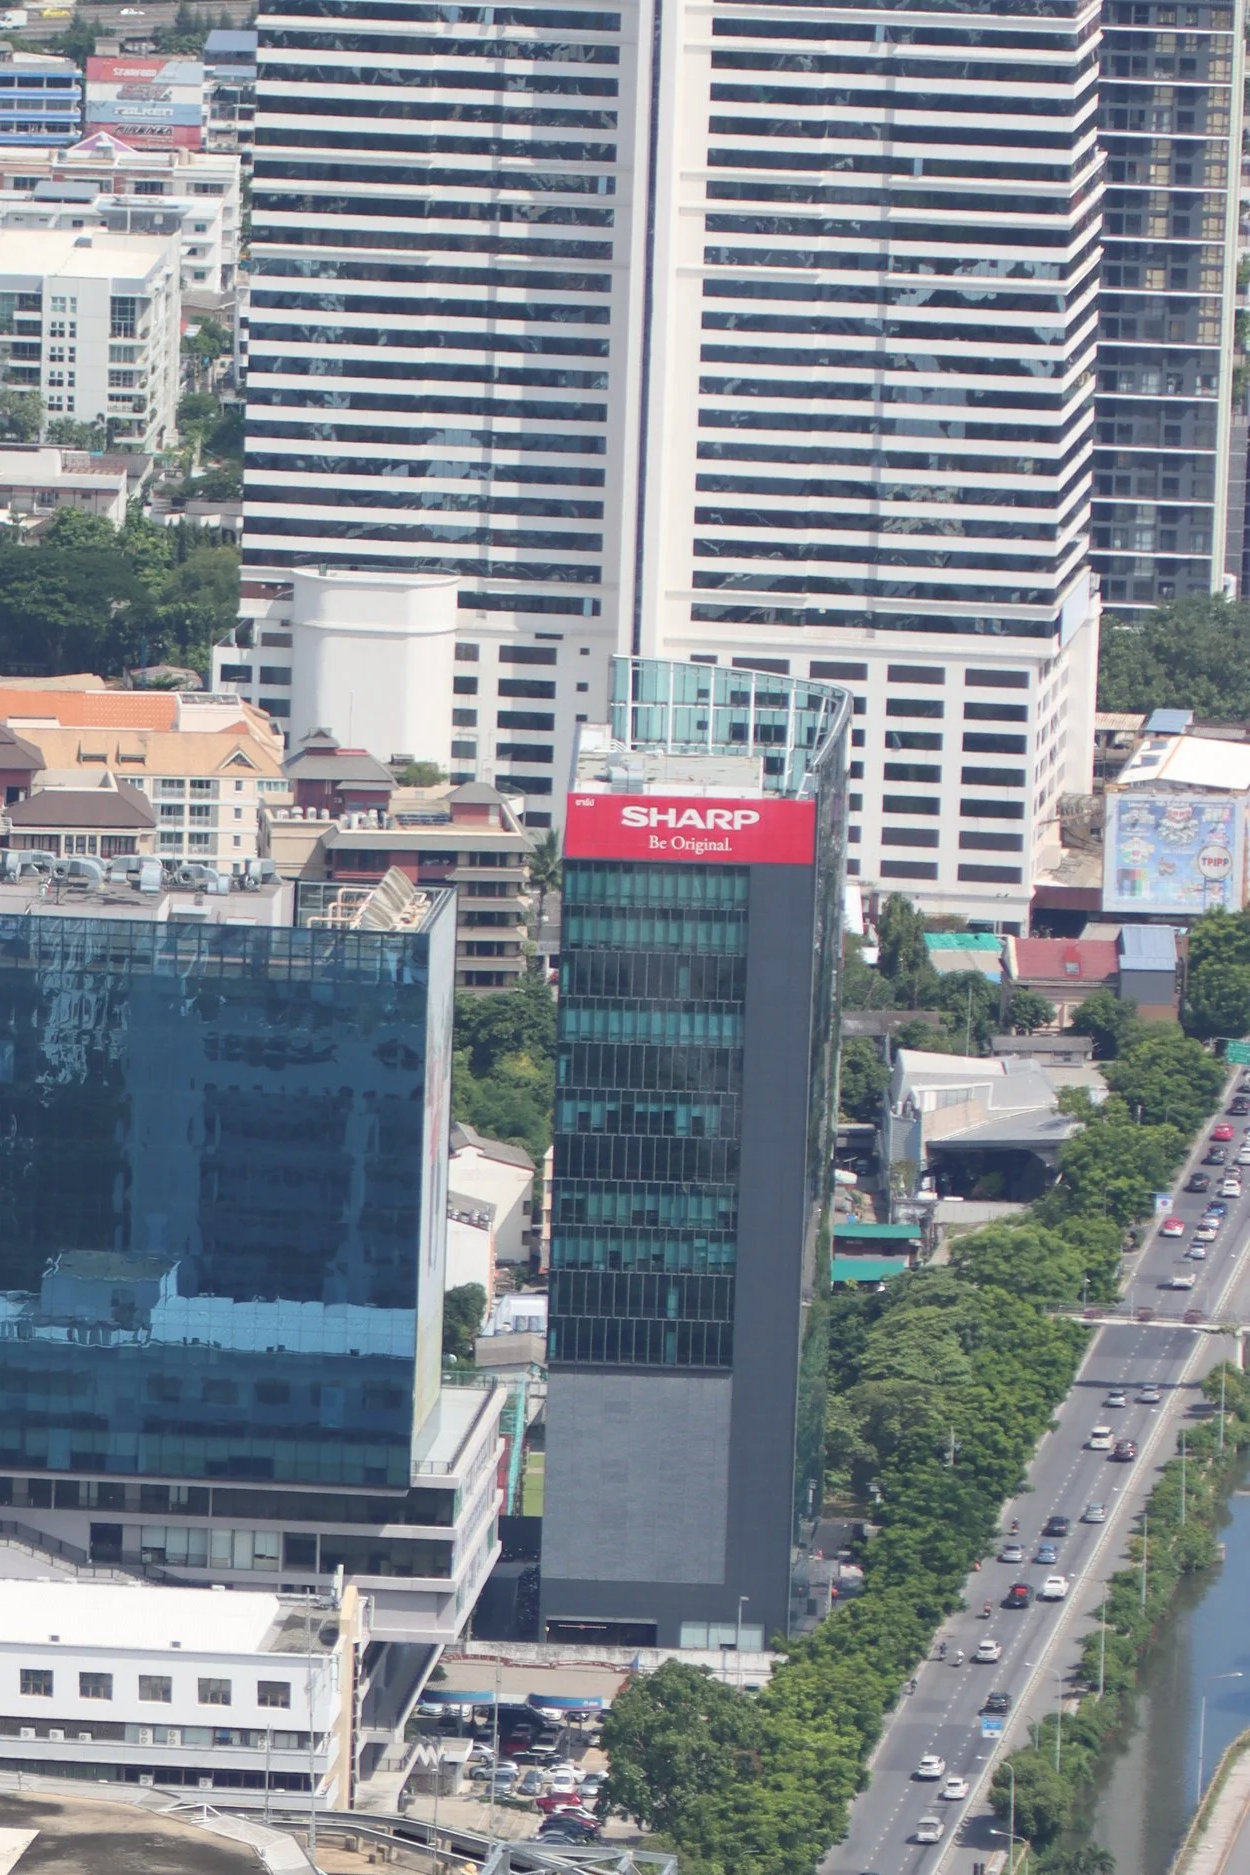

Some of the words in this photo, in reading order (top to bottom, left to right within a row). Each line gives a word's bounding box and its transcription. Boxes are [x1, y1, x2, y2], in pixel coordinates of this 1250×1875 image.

[621, 805, 760, 831] SHARP
[649, 835, 667, 849] Be
[671, 836, 732, 855] Original.
[1201, 857, 1230, 868] TPIPP
